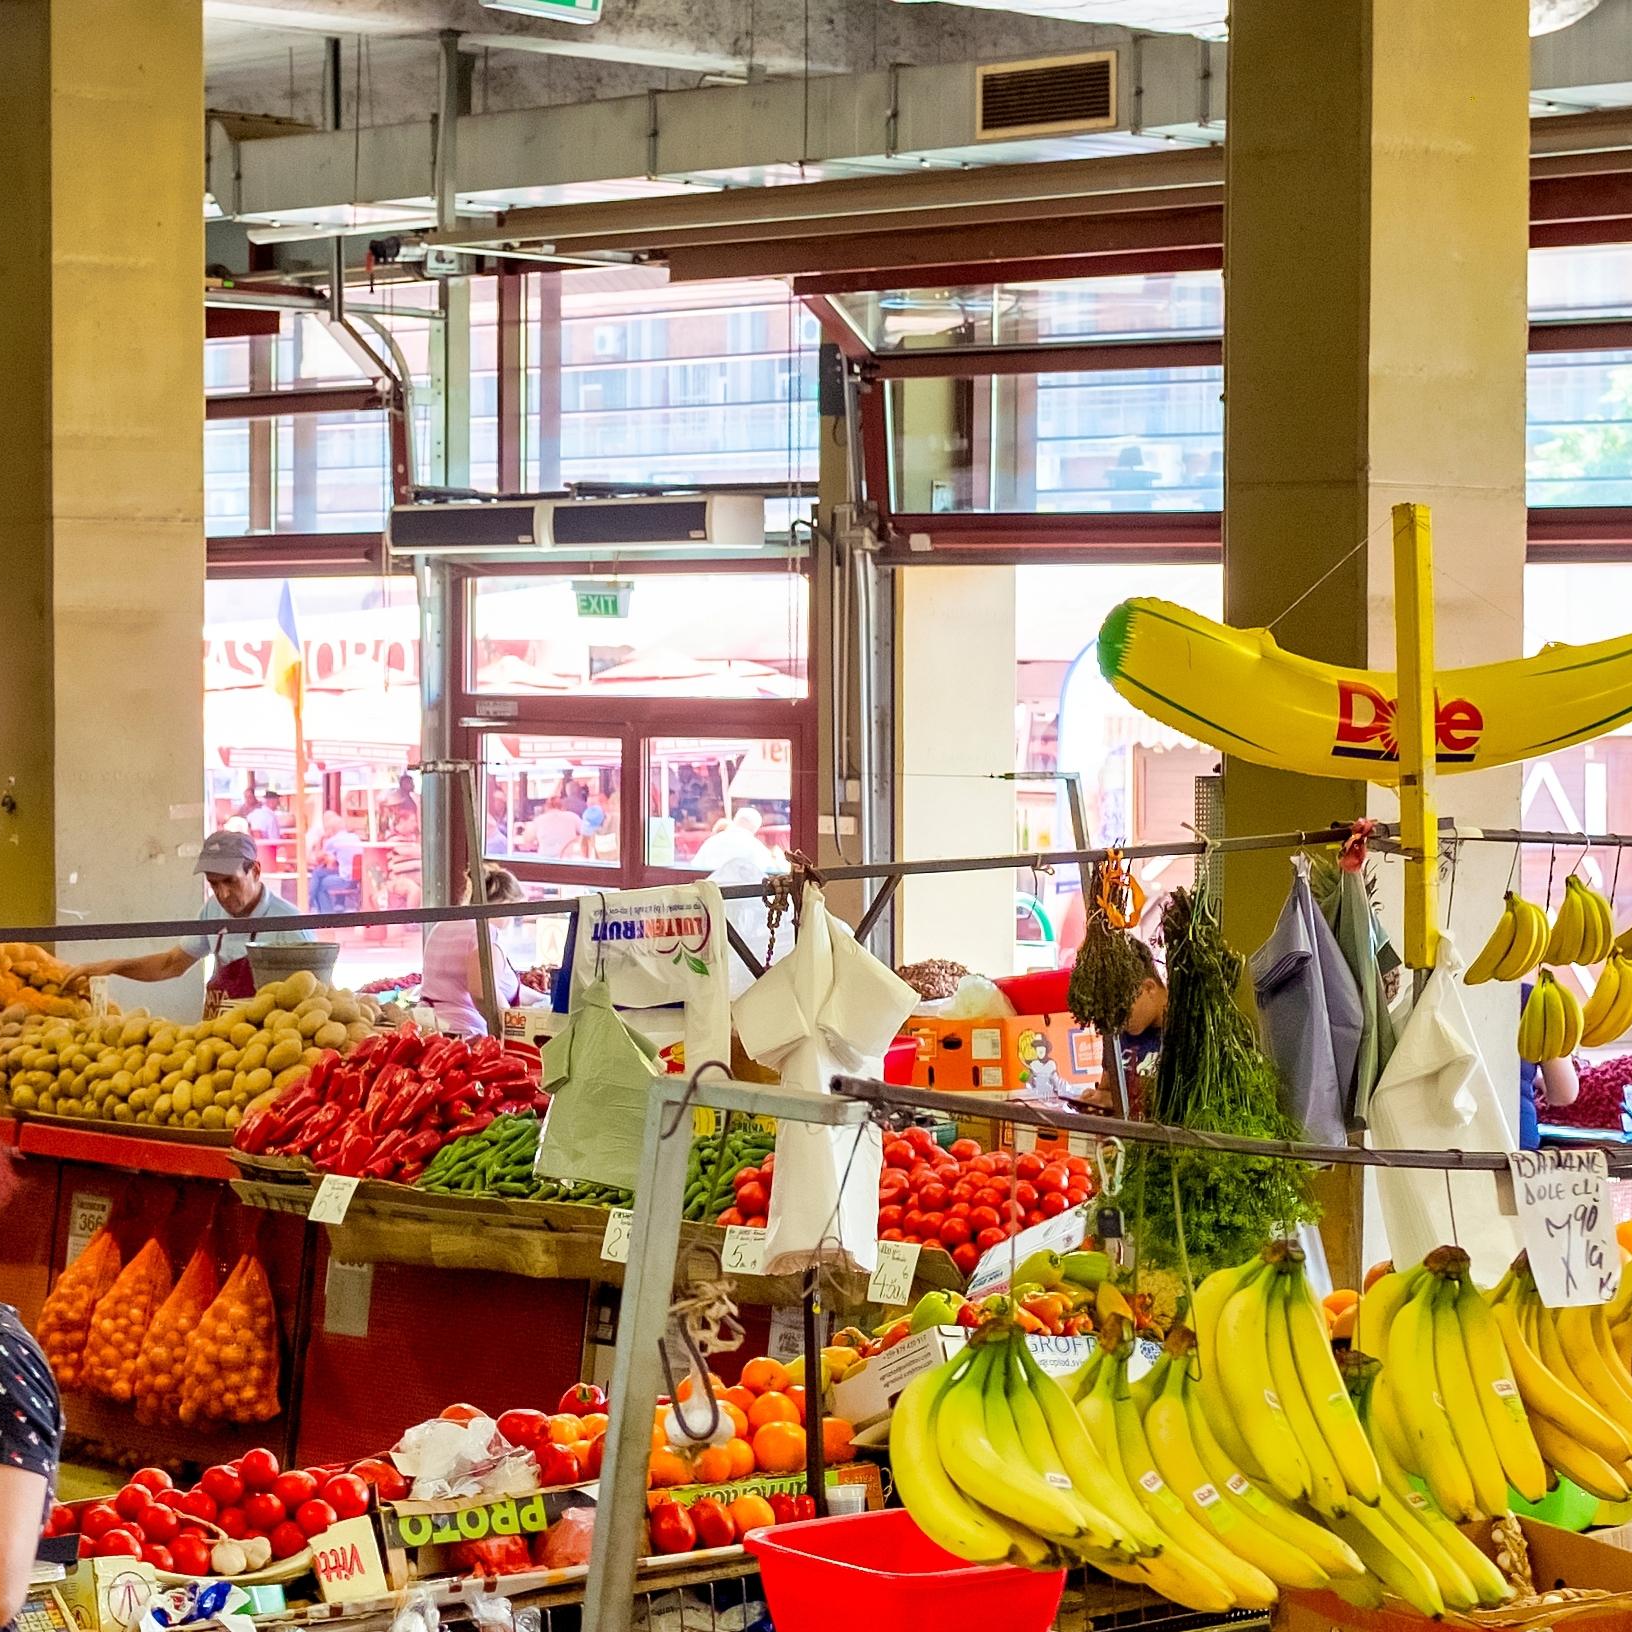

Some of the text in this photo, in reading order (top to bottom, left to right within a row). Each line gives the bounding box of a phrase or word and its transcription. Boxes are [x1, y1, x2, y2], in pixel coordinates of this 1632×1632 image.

[579, 594, 616, 616] EXIT
[1336, 680, 1484, 753] De
[504, 1011, 527, 1028] Dole
[398, 1494, 548, 1547] PROTO
